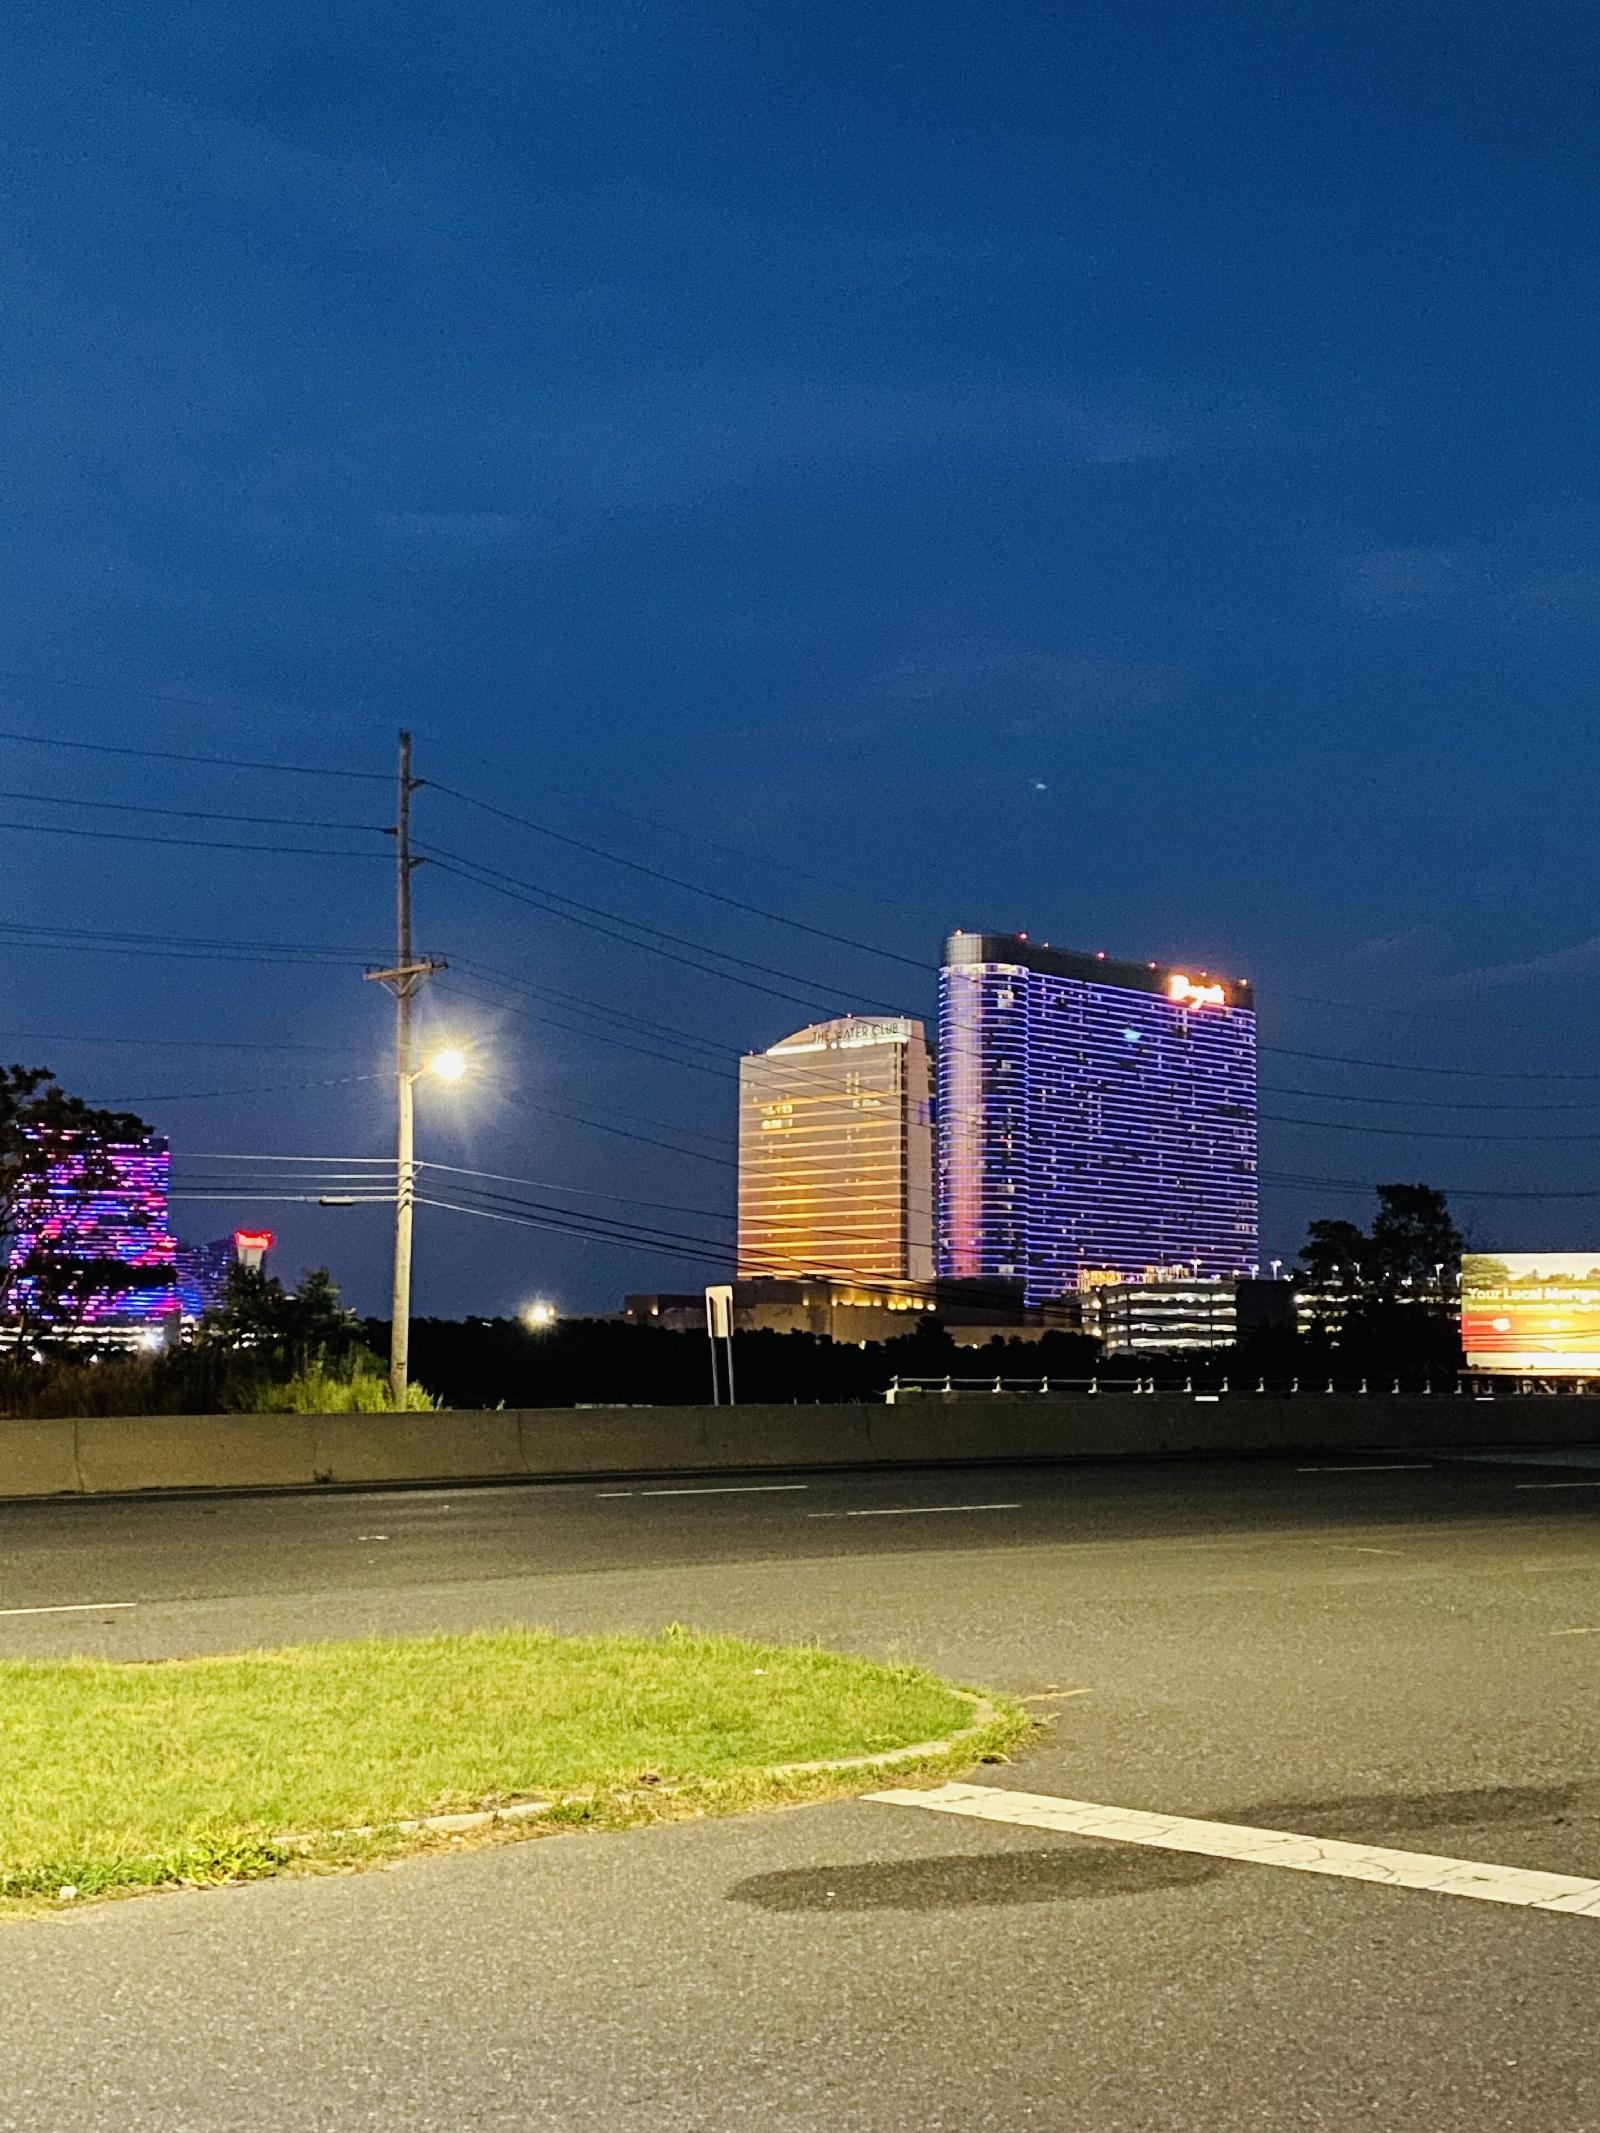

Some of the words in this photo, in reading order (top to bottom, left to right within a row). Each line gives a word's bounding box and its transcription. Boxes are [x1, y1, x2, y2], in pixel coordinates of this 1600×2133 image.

[812, 1031, 830, 1043] THE
[872, 1023, 898, 1037] CLUB
[1468, 1287, 1501, 1300] Your
[1504, 1287, 1543, 1300] Local
